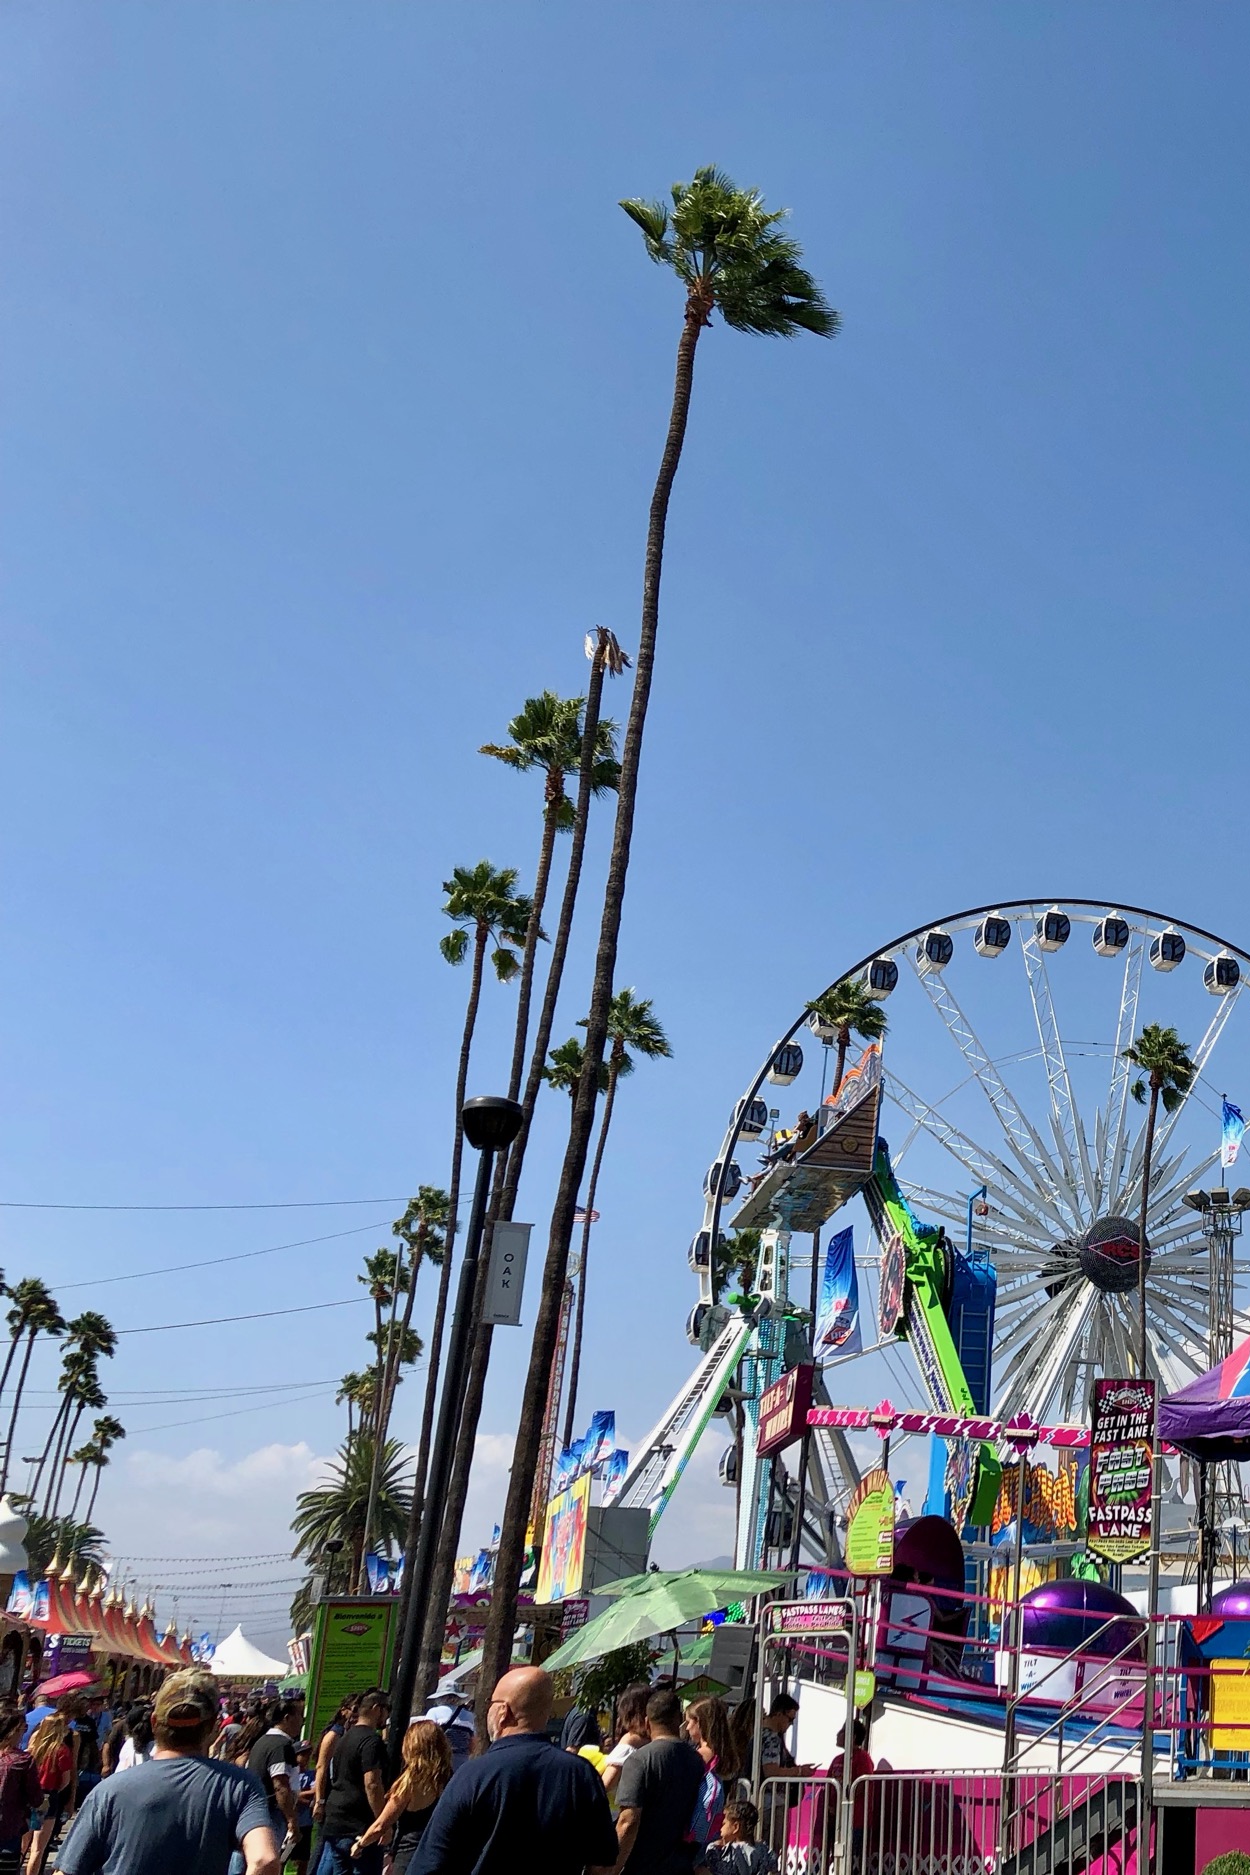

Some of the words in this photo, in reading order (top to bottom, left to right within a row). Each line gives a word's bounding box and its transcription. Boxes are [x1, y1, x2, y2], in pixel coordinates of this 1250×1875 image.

[502, 1253, 515, 1289] OAK
[1097, 1416, 1116, 1430] GET
[1116, 1415, 1128, 1427] IN
[1130, 1412, 1148, 1425] THE
[1093, 1429, 1119, 1444] FAST
[1096, 1447, 1146, 1472] FAST
[1097, 1469, 1151, 1496] PASS
[1088, 1505, 1153, 1523] FASTPASS
[1098, 1523, 1142, 1538] LANE
[1024, 1659, 1038, 1667] TILT
[1120, 1667, 1132, 1675] TILT
